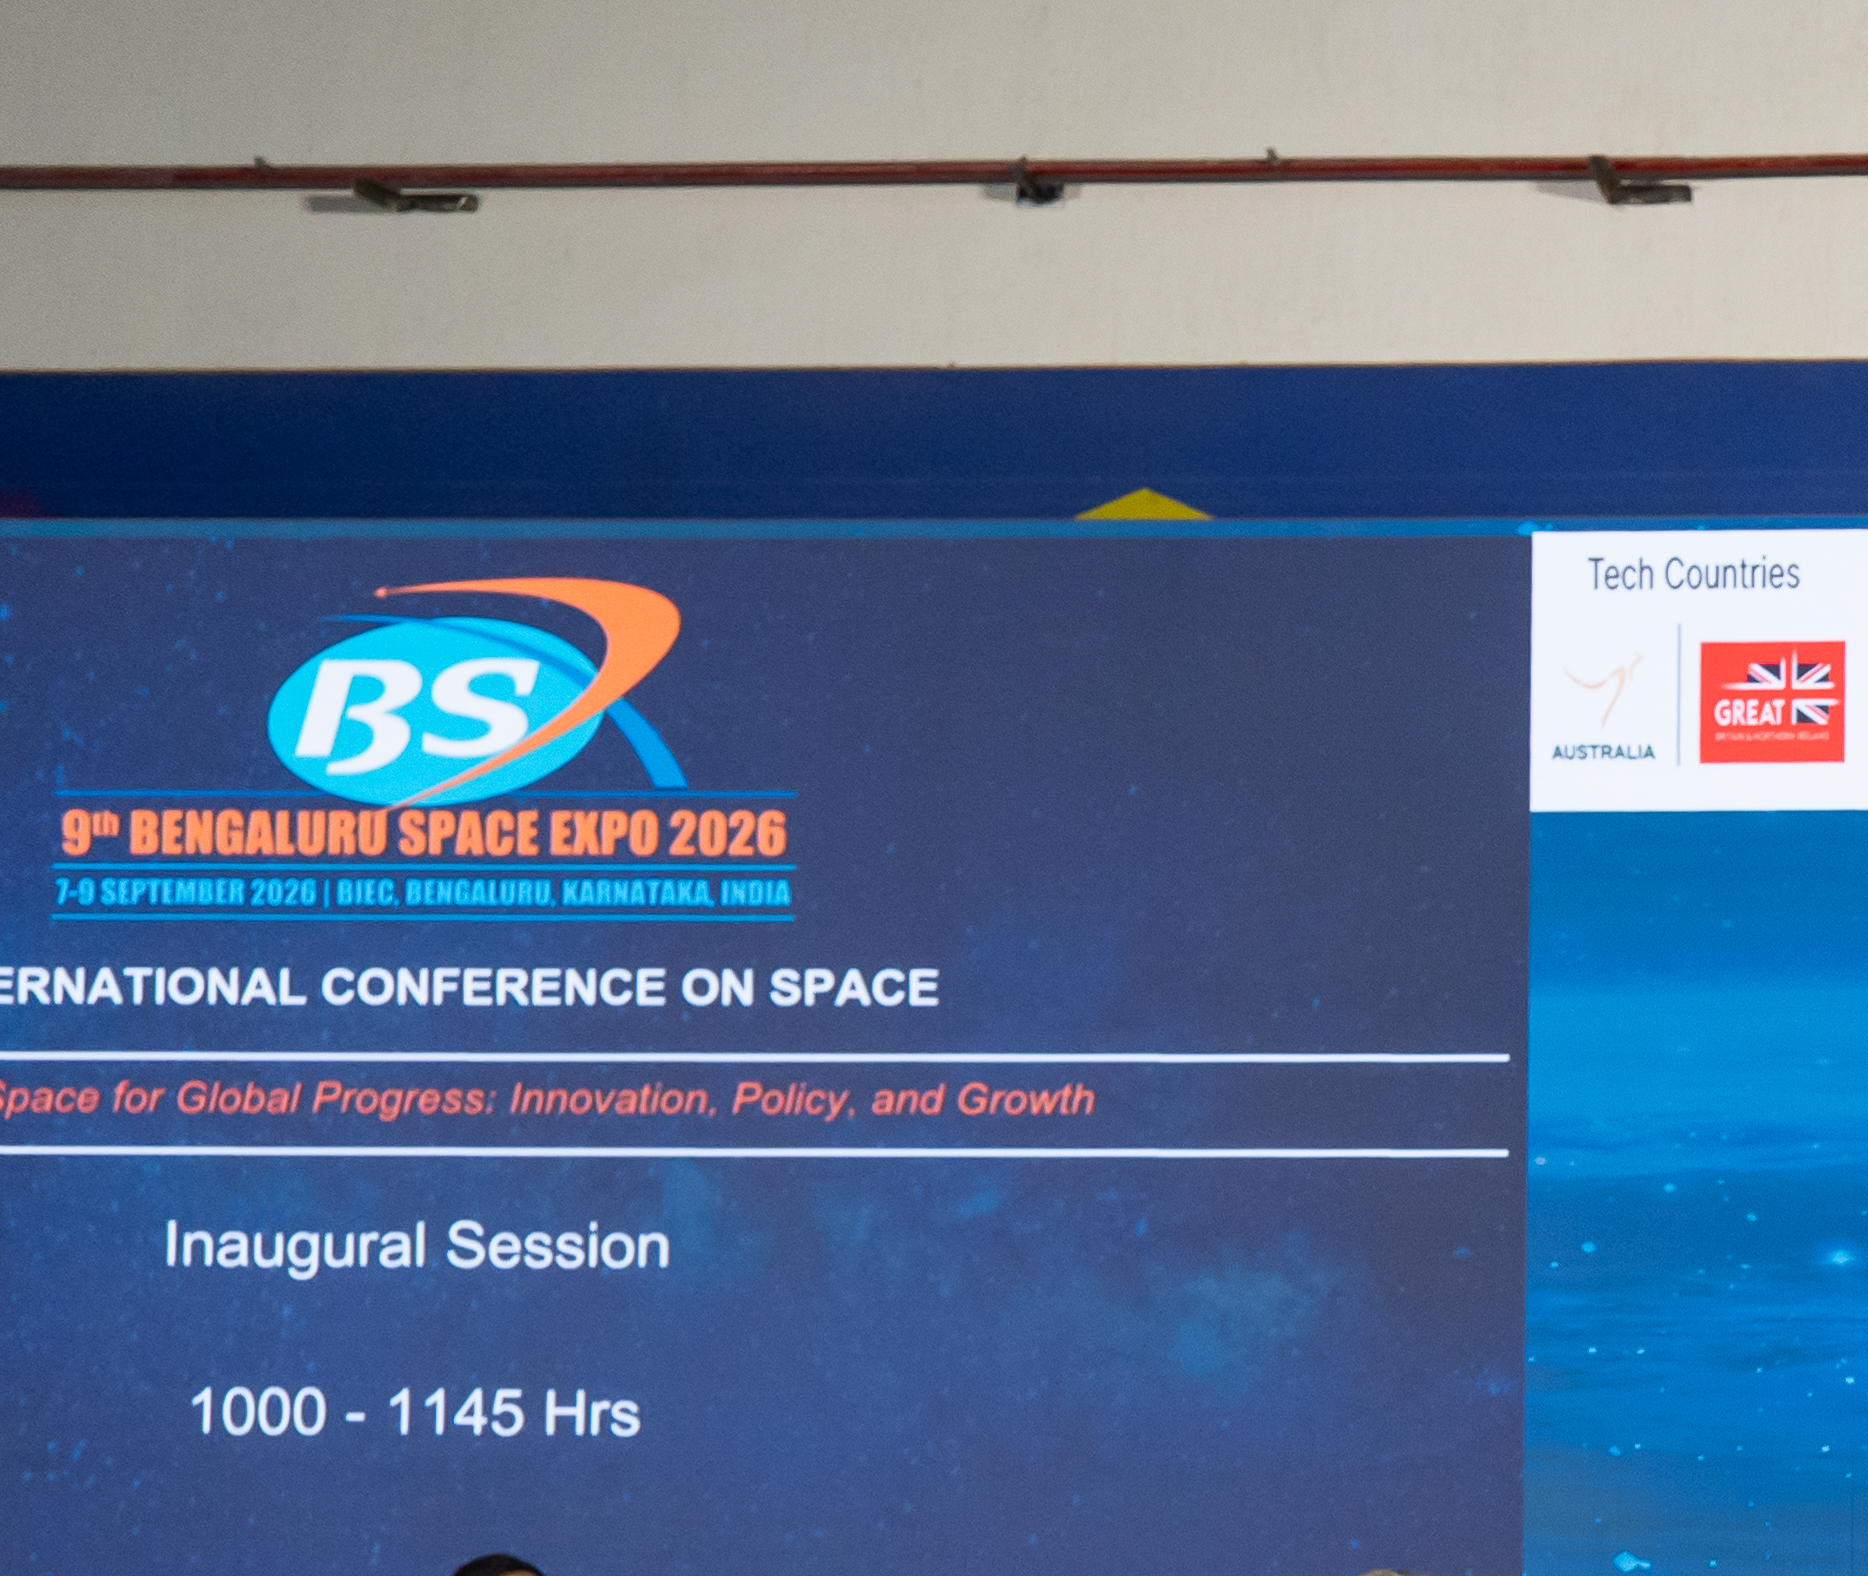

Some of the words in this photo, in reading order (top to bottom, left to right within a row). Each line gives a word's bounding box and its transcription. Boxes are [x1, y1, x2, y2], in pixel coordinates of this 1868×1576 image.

[1587, 556, 1654, 591] Tech
[1664, 555, 1800, 590] Countries
[1714, 698, 1786, 727] GREAT
[1552, 744, 1655, 761] AUSTRALIA
[63, 808, 120, 856] 9th
[130, 808, 390, 856] BENGALURU
[399, 809, 540, 857] SPACE
[551, 809, 660, 856] EXPO
[670, 809, 787, 857] 2026
[55, 877, 96, 906] 7-9
[100, 877, 246, 906] SEPTEMBER
[250, 877, 317, 907] 2026
[336, 878, 400, 907] BIEC,
[405, 878, 557, 908] BENGALURU,
[561, 878, 716, 908] KARNATAKA,
[720, 879, 791, 907] INDIA
[322, 967, 666, 1006] CONFERENCE
[682, 968, 754, 1006] ON
[770, 968, 939, 1007] SPACE
[0, 1079, 101, 1119] pace
[114, 1079, 166, 1114] for
[178, 1079, 303, 1115] Global
[313, 1080, 497, 1122] Progress:
[511, 1082, 717, 1115] Innovation,
[733, 1080, 856, 1122] Policy,
[872, 1083, 947, 1116] and
[958, 1081, 1096, 1116] Growth
[167, 1219, 426, 1281] Inaugural
[447, 1219, 670, 1270] Session
[192, 1386, 327, 1436] 1000
[390, 1387, 525, 1437] 1145
[546, 1389, 641, 1437] Hrs
